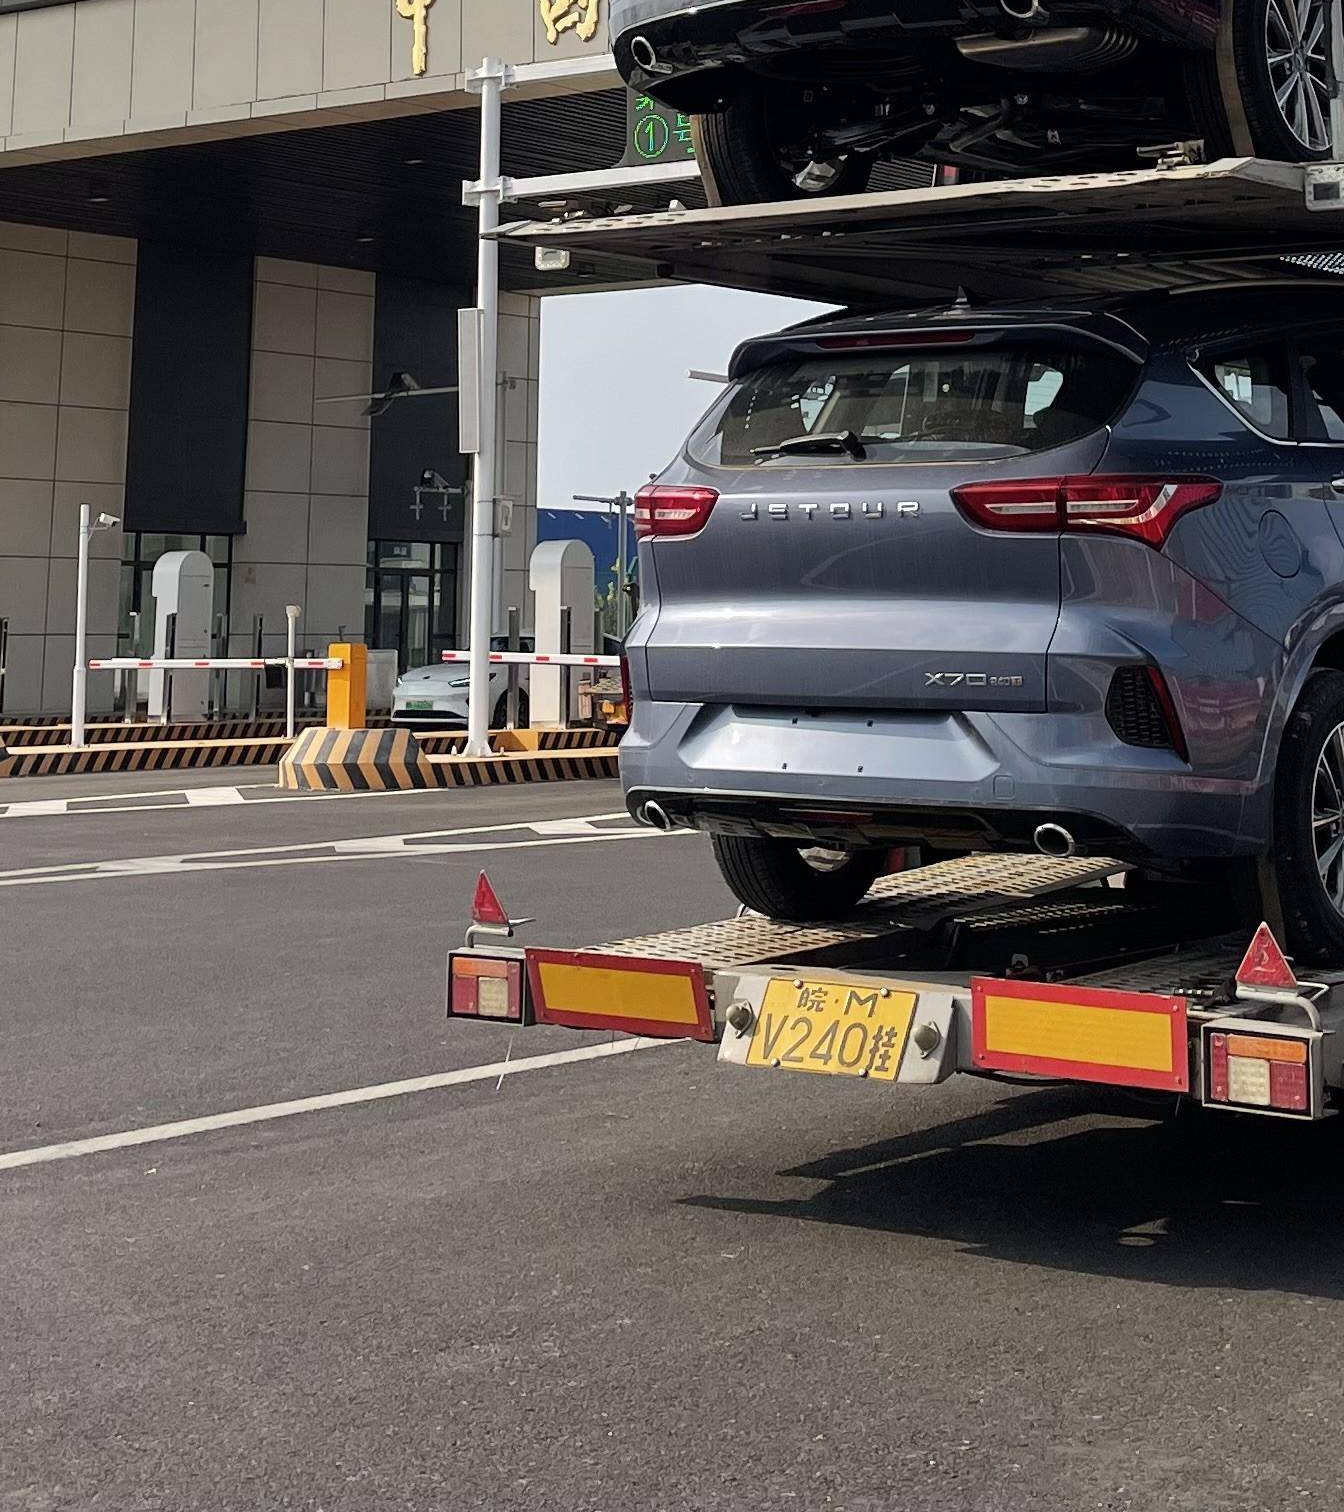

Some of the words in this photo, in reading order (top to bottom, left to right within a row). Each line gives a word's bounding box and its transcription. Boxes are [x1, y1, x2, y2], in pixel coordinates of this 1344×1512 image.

[738, 500, 922, 521] JETOUR
[923, 672, 987, 687] X70
[761, 1012, 898, 1073] V240挂
